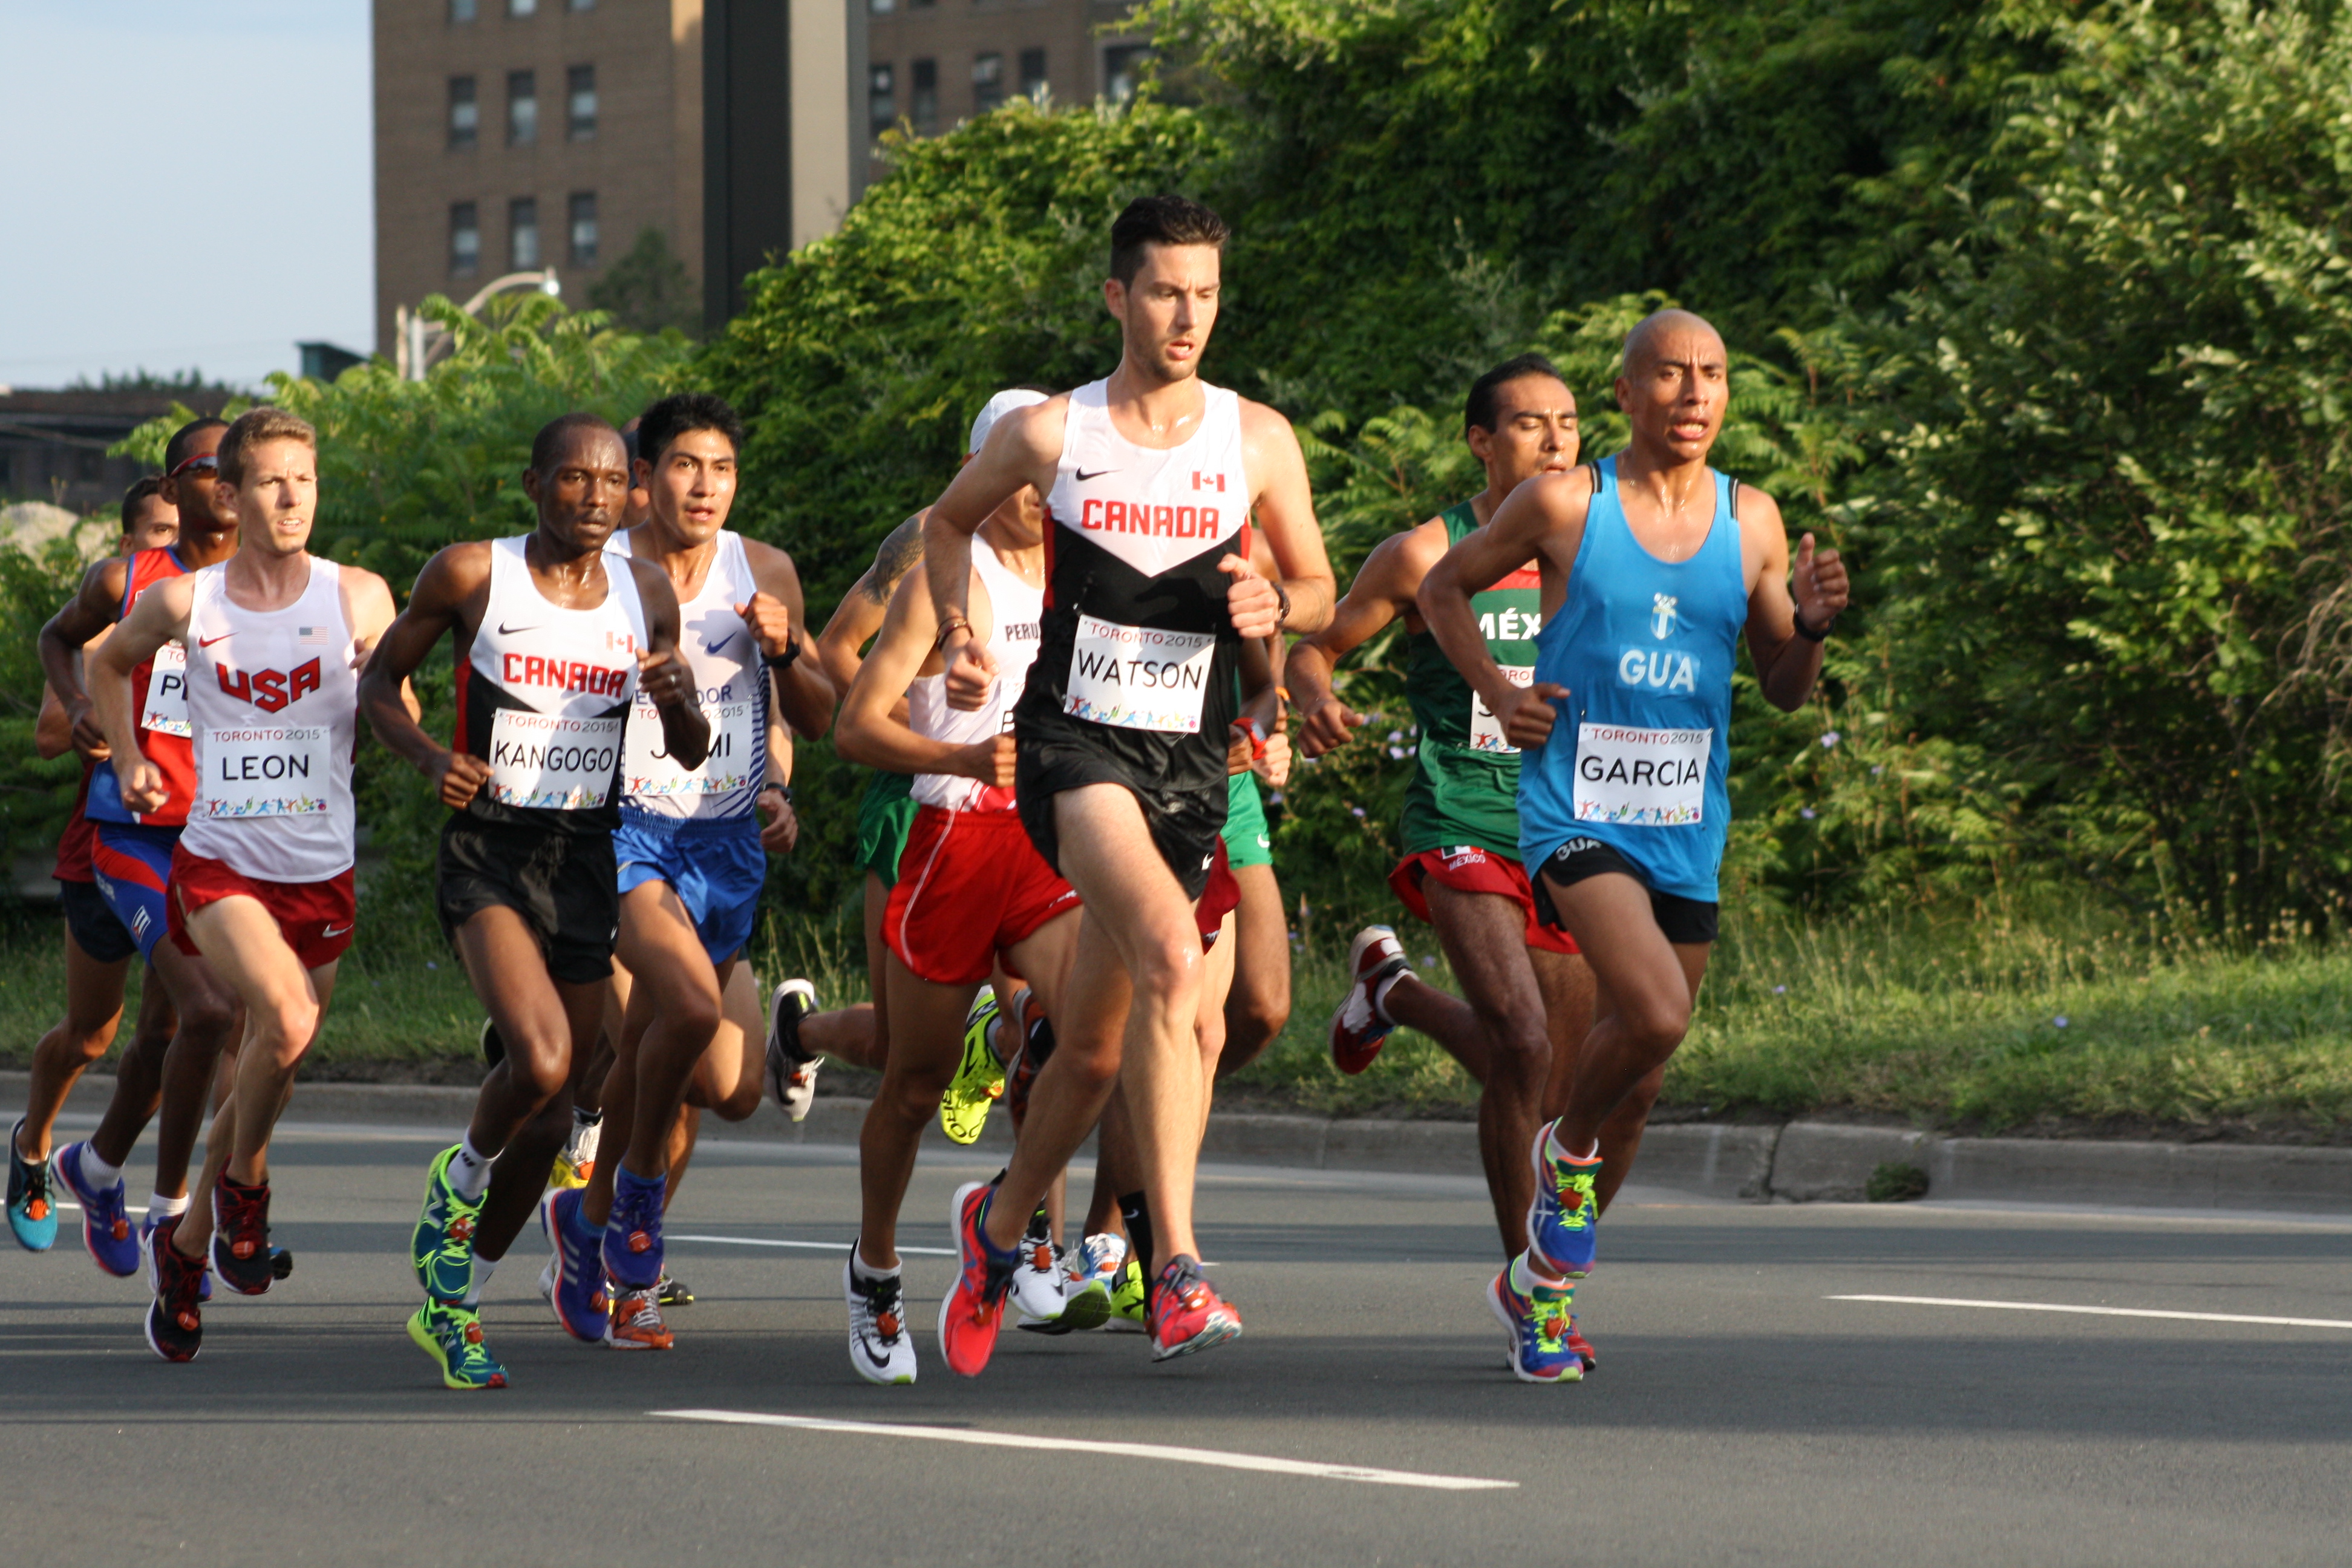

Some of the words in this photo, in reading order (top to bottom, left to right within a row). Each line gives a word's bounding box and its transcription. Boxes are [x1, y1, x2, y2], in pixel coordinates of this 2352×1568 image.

[1081, 499, 1220, 540] CANADA
[1005, 622, 1039, 642] PERU
[215, 655, 320, 714] USA
[503, 653, 628, 698] CANADA
[1078, 647, 1203, 690] WATSON
[1619, 648, 1694, 692] GUA
[223, 754, 309, 780] LEON
[494, 739, 613, 772] KANGOGO
[1581, 756, 1700, 787] GARCIA
